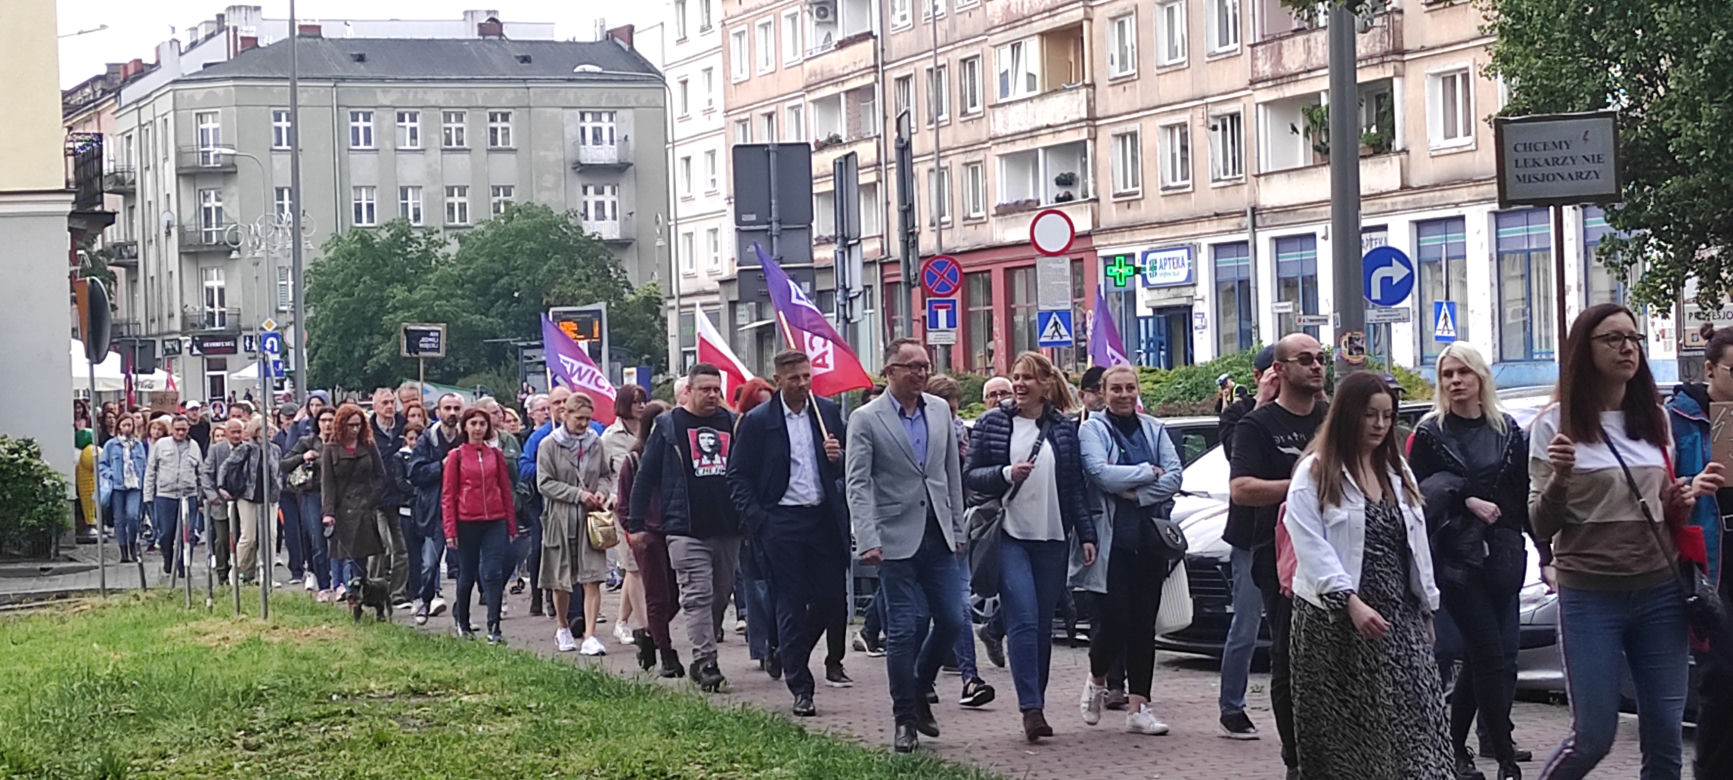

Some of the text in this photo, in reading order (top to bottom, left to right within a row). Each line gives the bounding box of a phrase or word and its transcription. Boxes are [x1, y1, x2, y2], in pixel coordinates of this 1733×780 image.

[1513, 140, 1571, 153] CHCEMY
[1515, 153, 1605, 169] LEKARZY NIE
[1515, 170, 1601, 184] MISJONARZY
[1159, 256, 1186, 271] APTEKA
